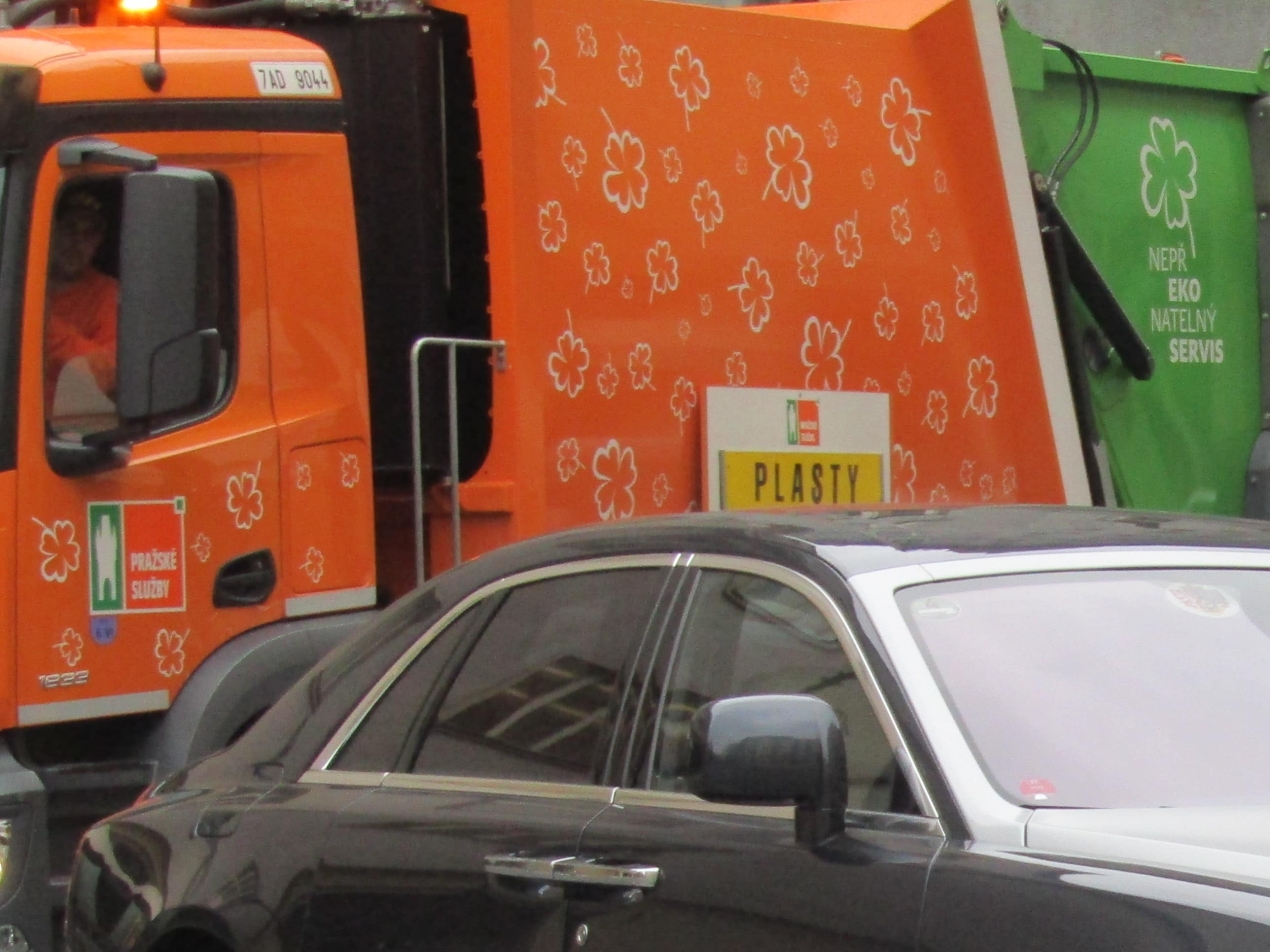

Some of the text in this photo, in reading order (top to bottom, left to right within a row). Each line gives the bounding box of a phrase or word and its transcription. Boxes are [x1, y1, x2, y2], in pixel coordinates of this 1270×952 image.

[257, 69, 329, 89] 7AD 9044
[1149, 242, 1187, 272] NEPŘ
[1168, 278, 1201, 302] EKO
[1151, 303, 1217, 333] NATELNÝ
[1169, 337, 1224, 364] SERVIS
[754, 462, 859, 504] PLASTY
[130, 548, 177, 572] PRAŽSKÉ
[131, 577, 170, 600] SLUŽBY
